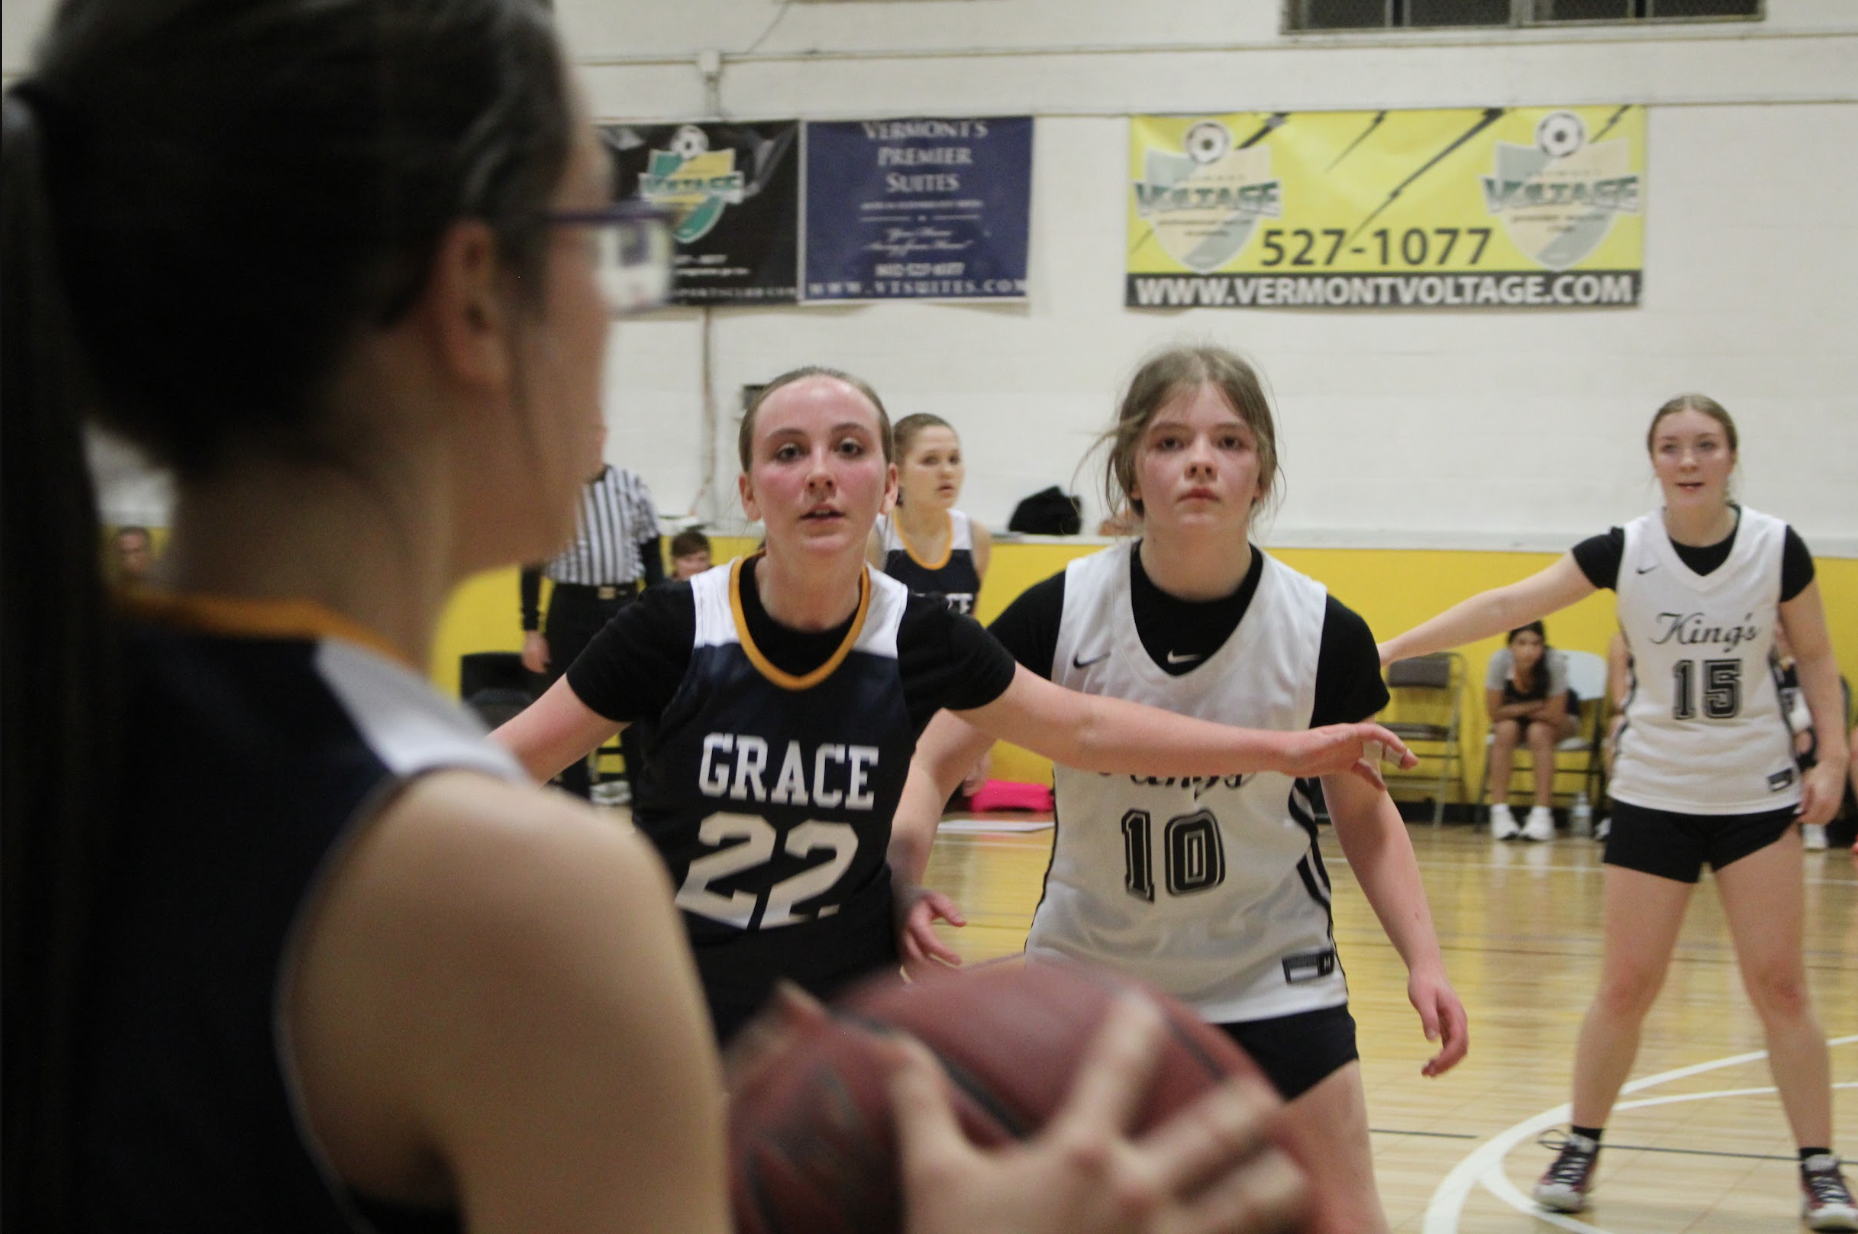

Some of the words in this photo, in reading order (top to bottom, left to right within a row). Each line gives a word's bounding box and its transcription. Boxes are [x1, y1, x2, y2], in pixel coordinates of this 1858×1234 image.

[876, 146, 973, 167] PREMIER
[885, 171, 961, 194] SUITES
[1259, 228, 1493, 268] 527-1077
[1137, 274, 1634, 308] WWW.VERMONTVOLTAGE.COM
[1649, 611, 1761, 653] King's
[1672, 658, 1743, 719] 15
[699, 732, 880, 811] GRACE
[675, 810, 860, 930] 22
[1120, 807, 1226, 904] 10
